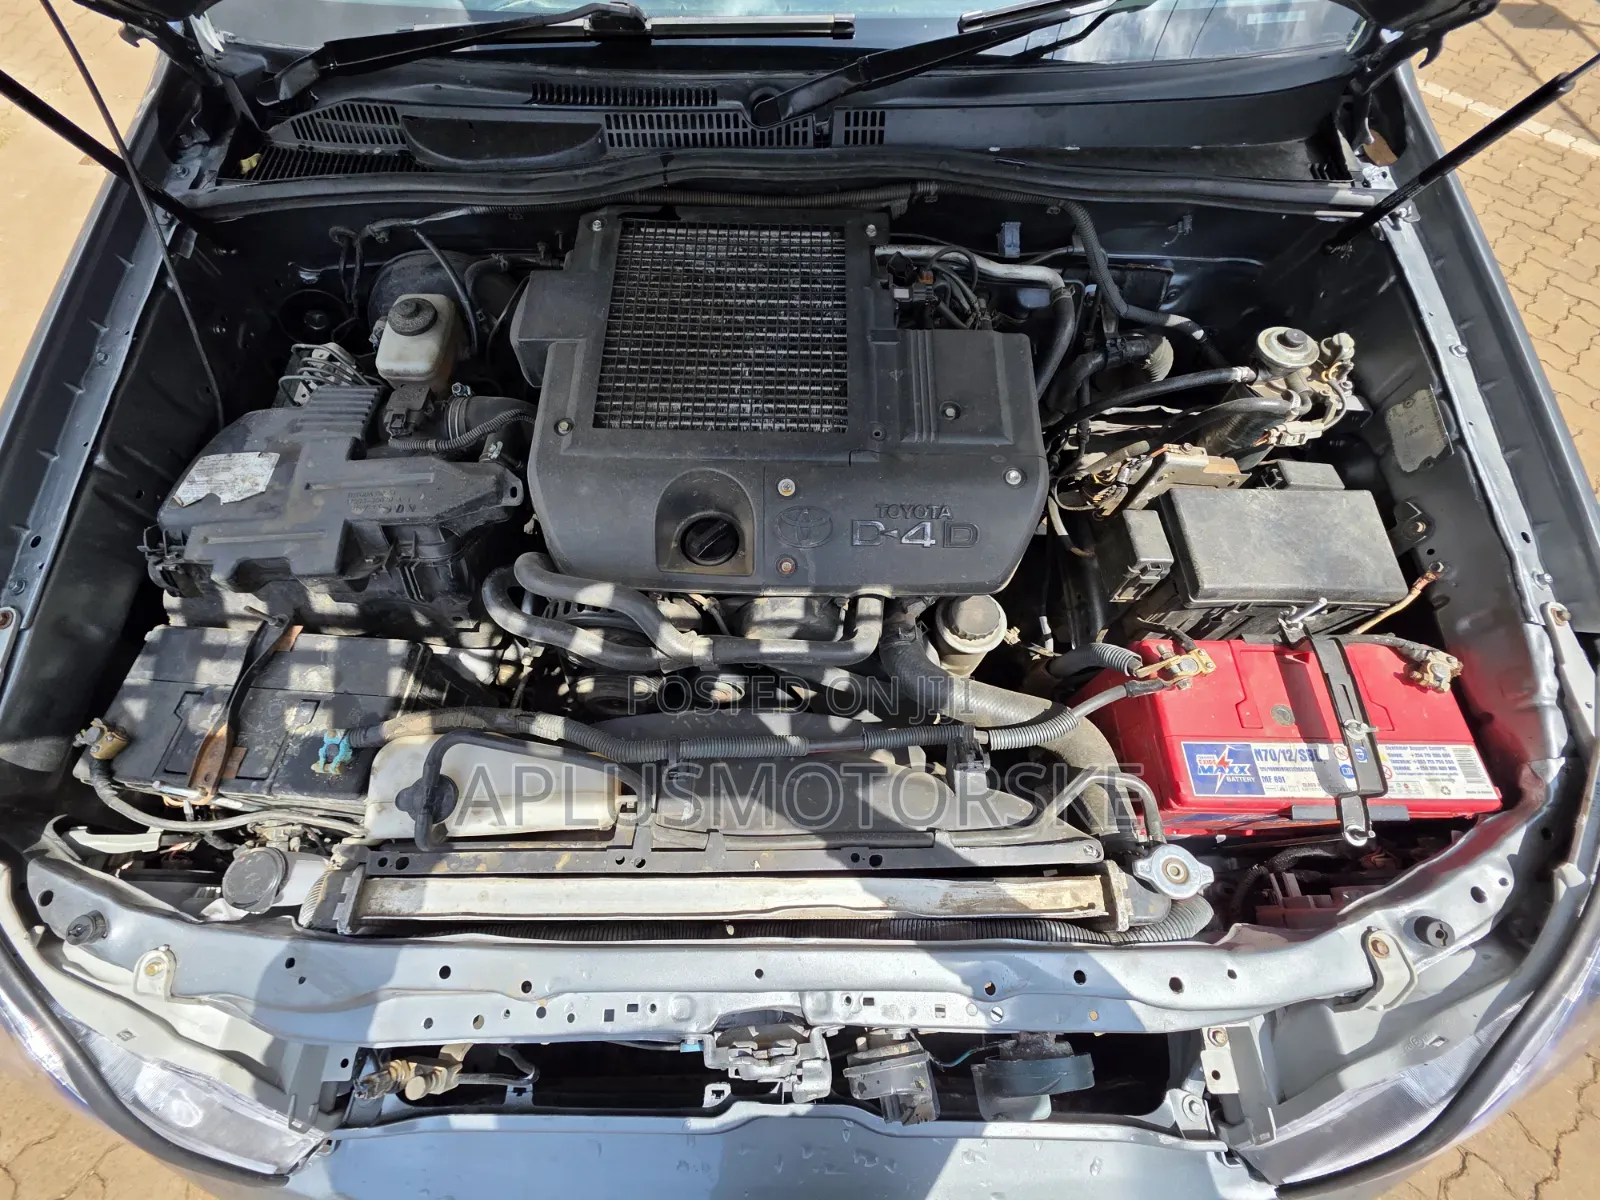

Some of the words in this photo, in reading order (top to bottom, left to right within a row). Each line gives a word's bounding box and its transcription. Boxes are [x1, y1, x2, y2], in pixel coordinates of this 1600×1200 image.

[875, 503, 953, 520] TOYOTA
[851, 519, 981, 549] D-4D
[1198, 765, 1249, 775] MAXX
[1261, 775, 1272, 783] MF
